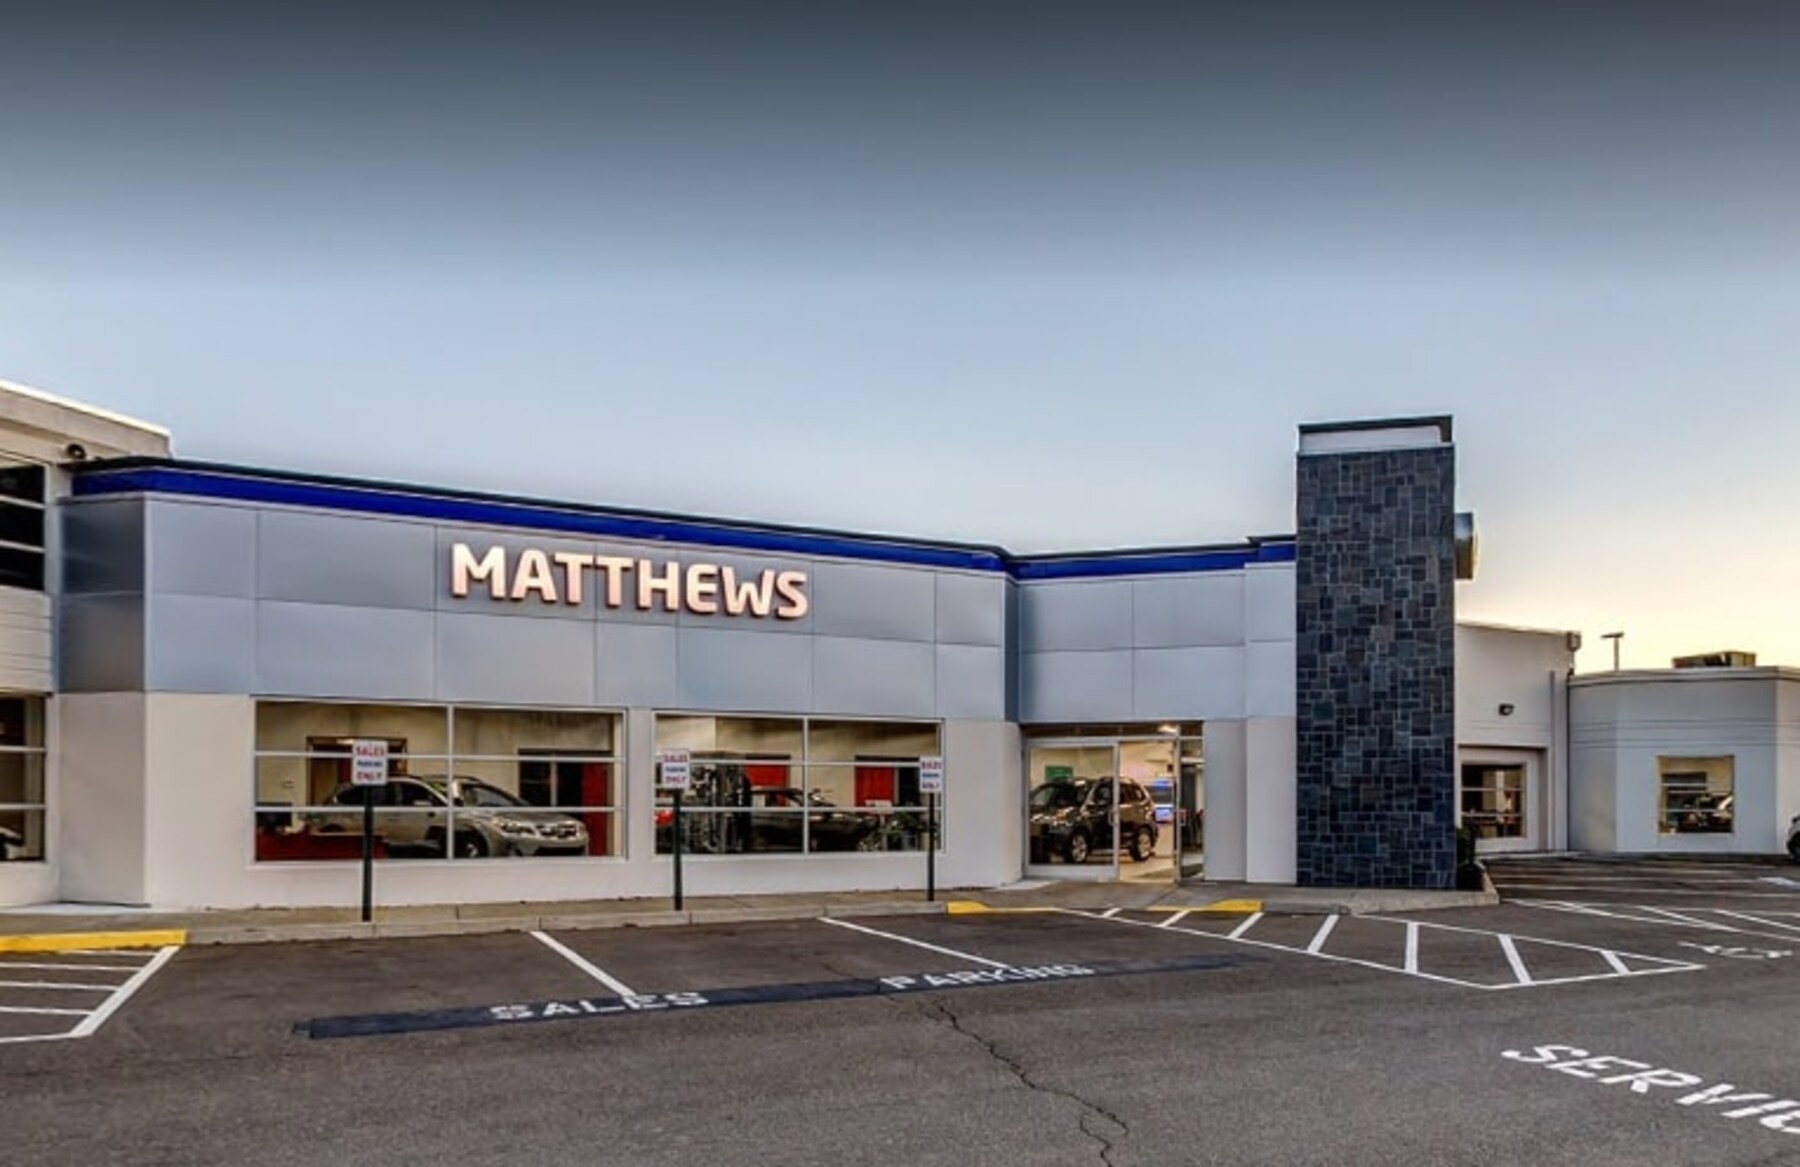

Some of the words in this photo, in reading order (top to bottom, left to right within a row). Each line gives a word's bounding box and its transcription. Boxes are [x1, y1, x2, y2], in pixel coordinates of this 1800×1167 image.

[451, 542, 809, 619] MATTHEWS
[490, 992, 709, 1020] SALES
[880, 964, 1096, 989] PARKING
